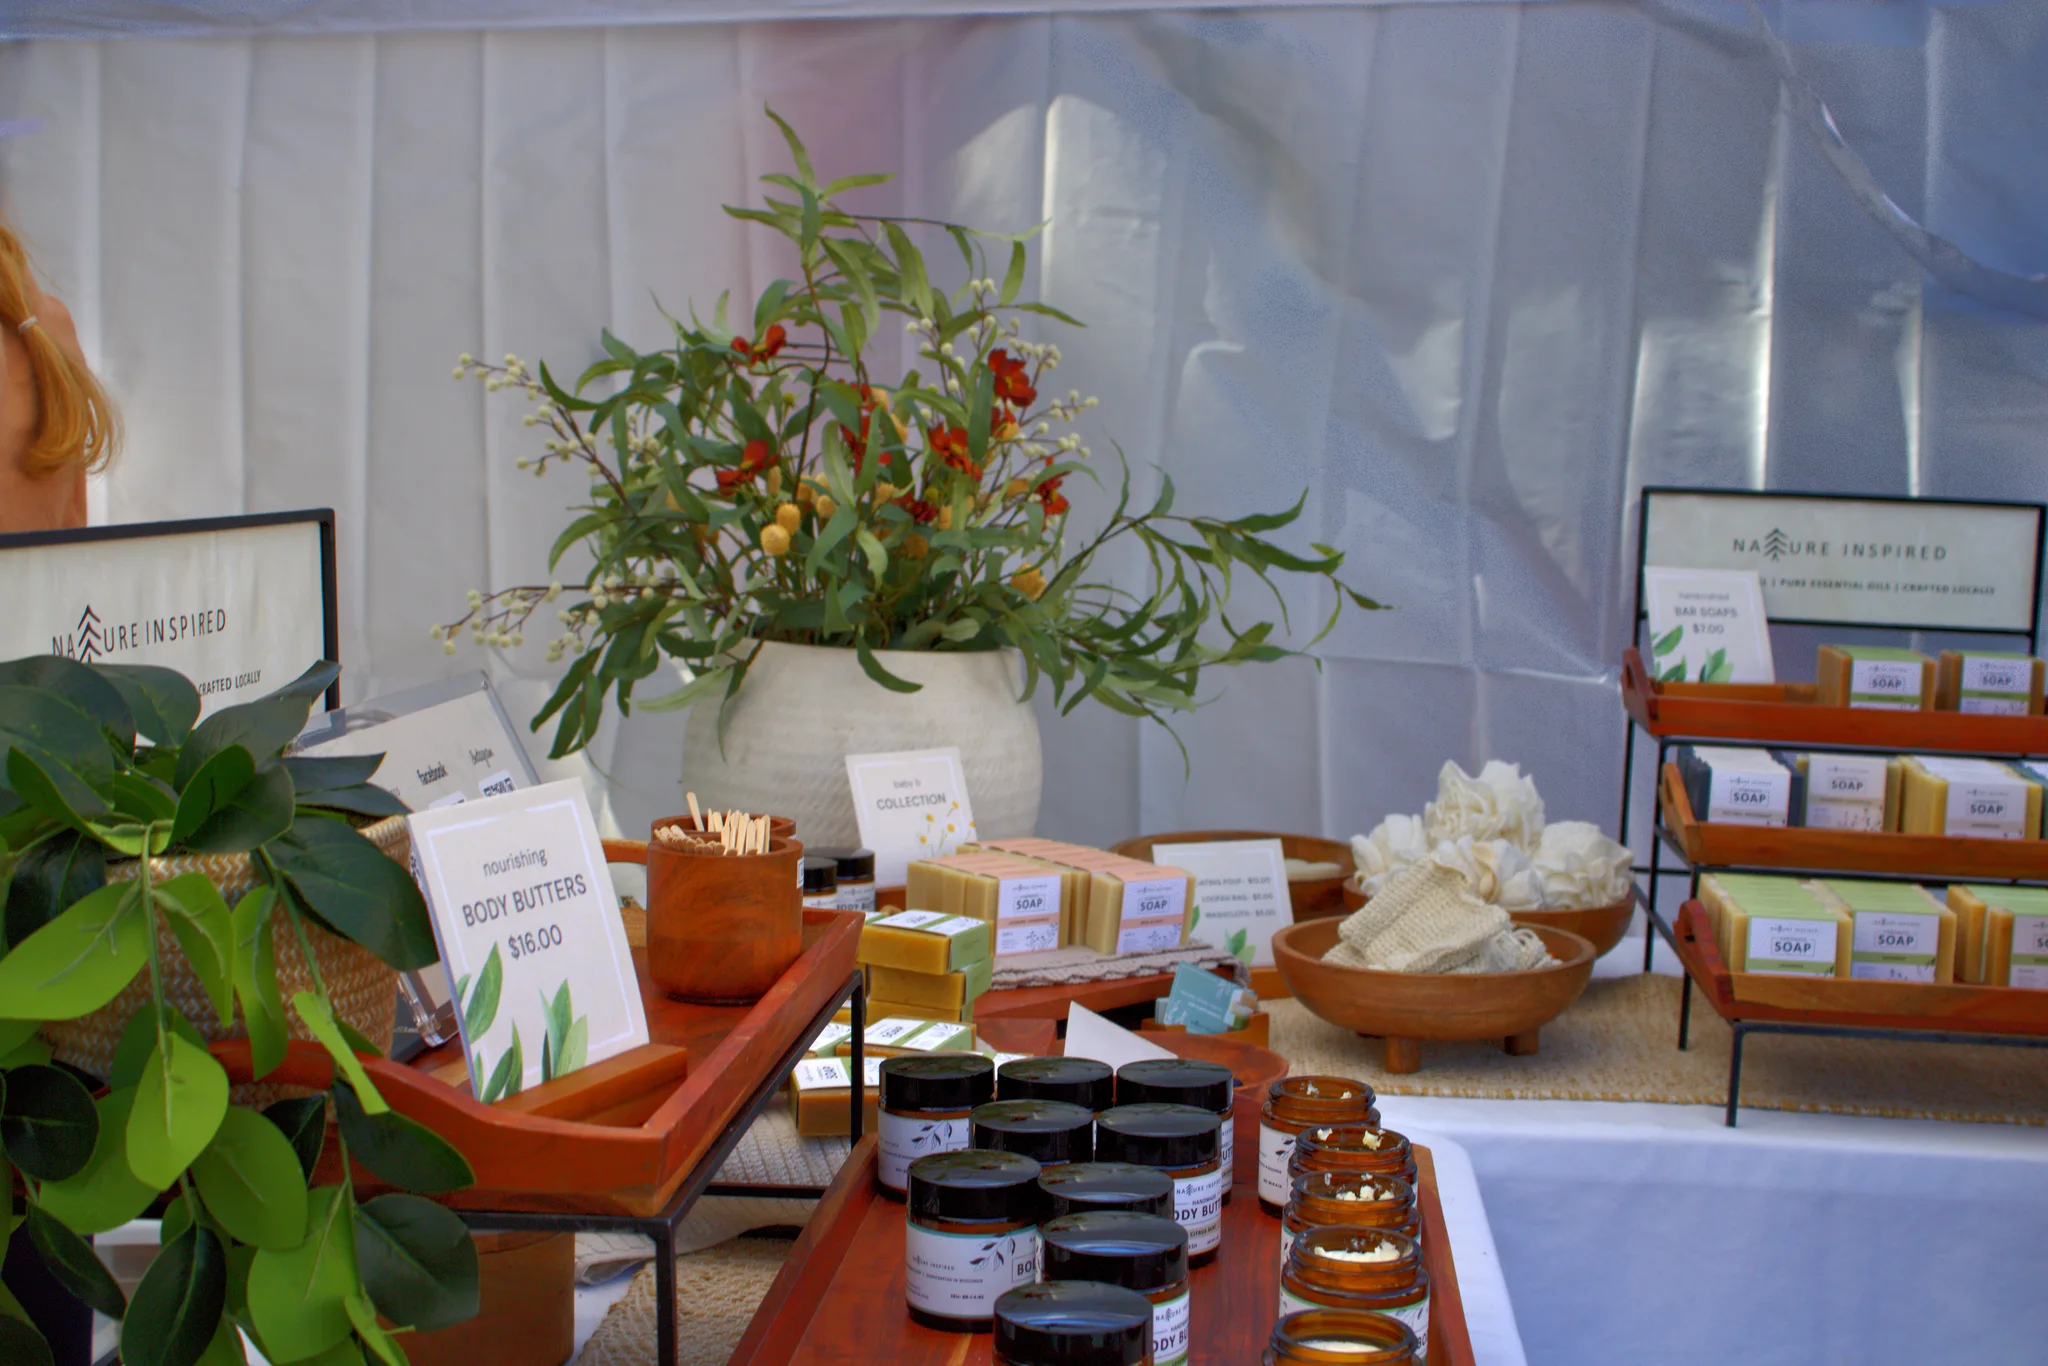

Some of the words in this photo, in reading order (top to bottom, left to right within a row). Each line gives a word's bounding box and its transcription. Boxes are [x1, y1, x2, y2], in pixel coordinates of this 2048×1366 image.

[1843, 542, 1947, 561] INSPIRED
[1674, 605, 1697, 617] BAR
[1700, 606, 1738, 619] SOAPS
[145, 608, 227, 645] INSPIRED
[199, 676, 232, 697] CRAFTED
[235, 669, 261, 689] LOCALLY
[1872, 677, 1903, 690] SOAP
[1982, 675, 2012, 687] SOAP
[1831, 780, 1864, 791] SOAP
[876, 792, 947, 812] COLLECTION
[1733, 791, 1768, 804] SOAP
[1969, 803, 2004, 815] SOAP
[482, 848, 549, 878] nourishing
[461, 893, 508, 928] BODY
[511, 873, 588, 914] BUTTERS
[1016, 898, 1043, 910] SOAP
[1140, 900, 1168, 912] SOAP
[507, 923, 563, 961] $16.00
[1774, 940, 1812, 953] SOAP
[1877, 933, 1914, 947] SOAP
